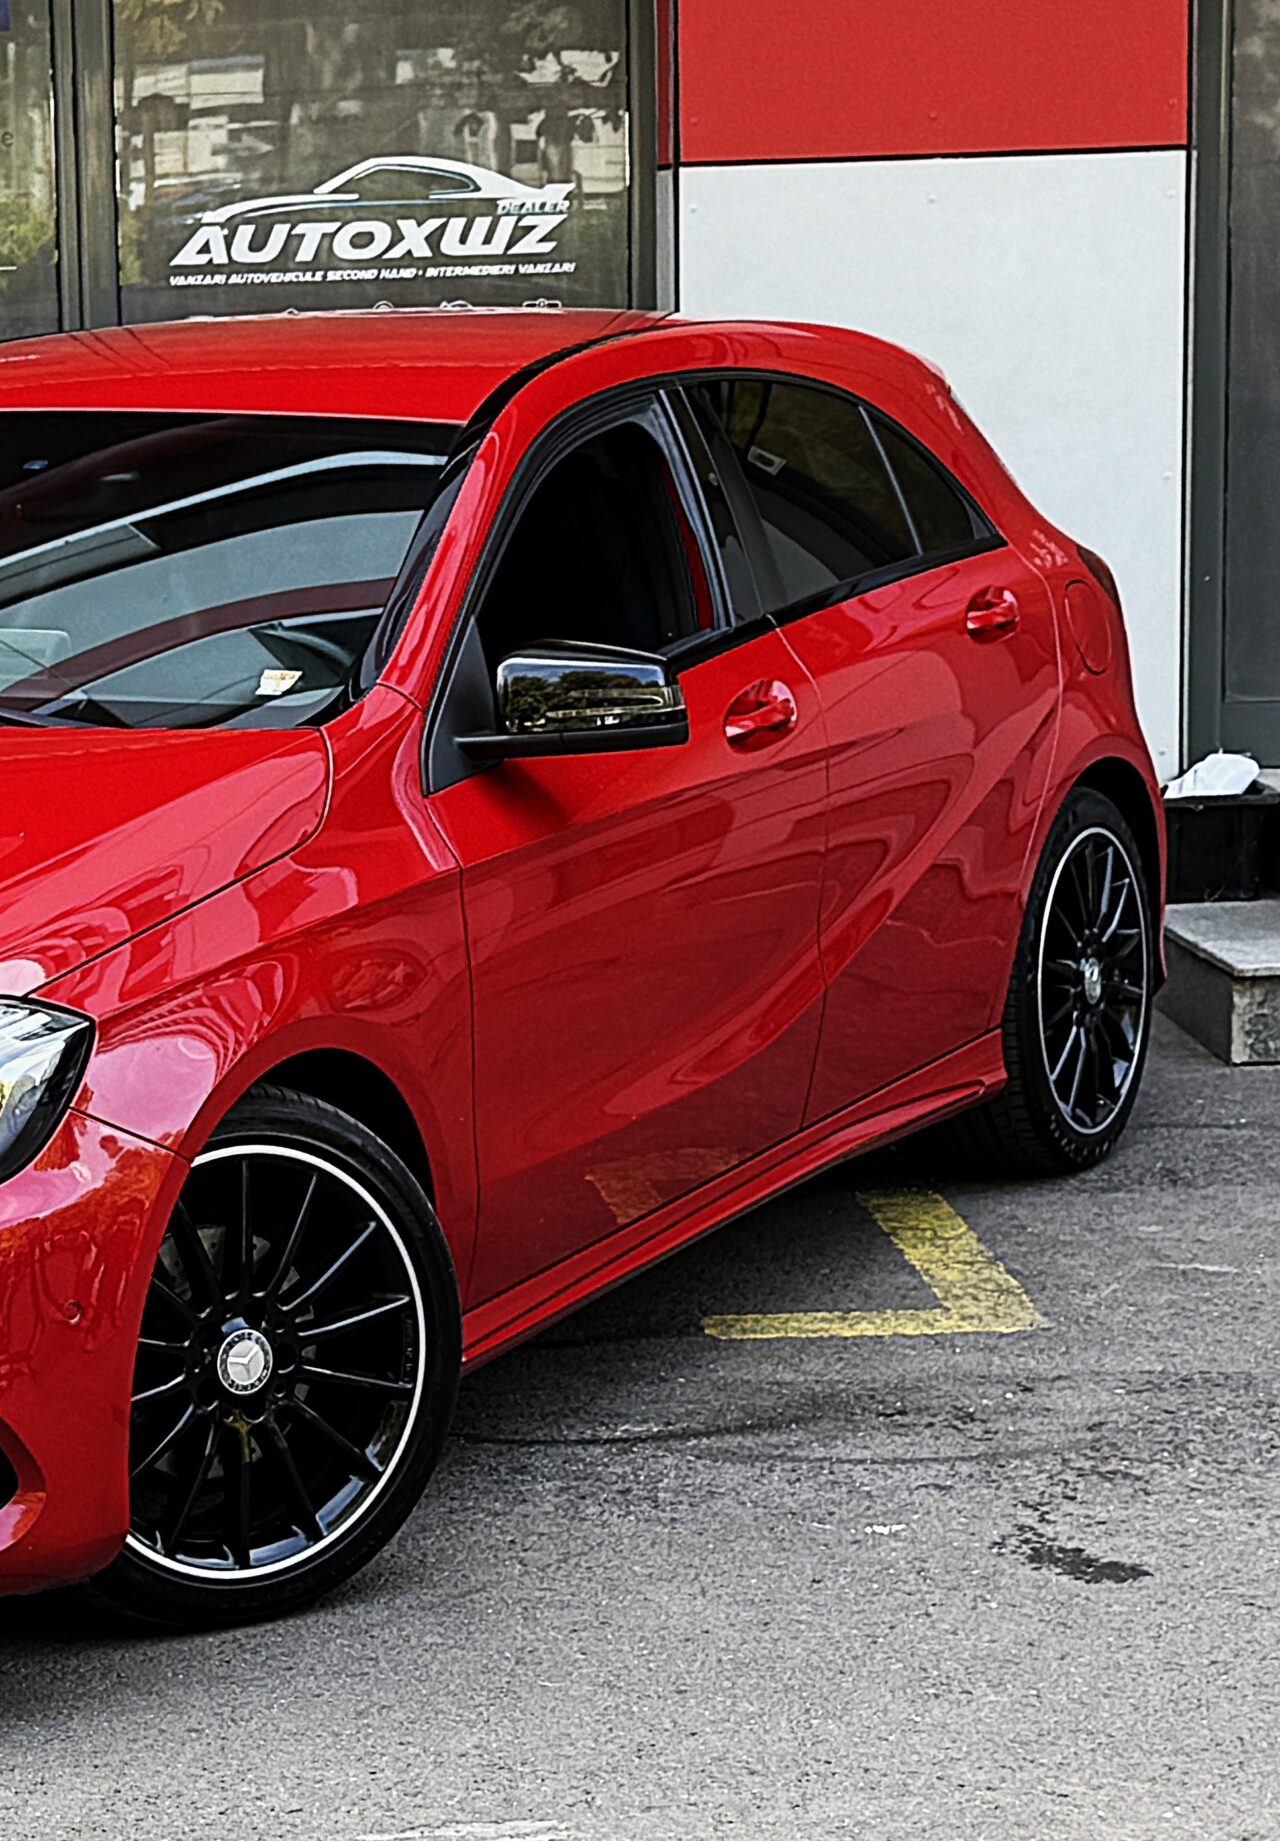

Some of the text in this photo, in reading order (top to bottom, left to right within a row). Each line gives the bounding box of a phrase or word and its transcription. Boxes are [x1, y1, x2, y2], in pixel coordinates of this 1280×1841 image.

[496, 199, 570, 215] DEALER
[170, 273, 226, 286] VANZARI
[228, 271, 323, 285] AUTOVEHICULE
[326, 268, 378, 282] SECOND
[518, 262, 576, 275] VANZARI
